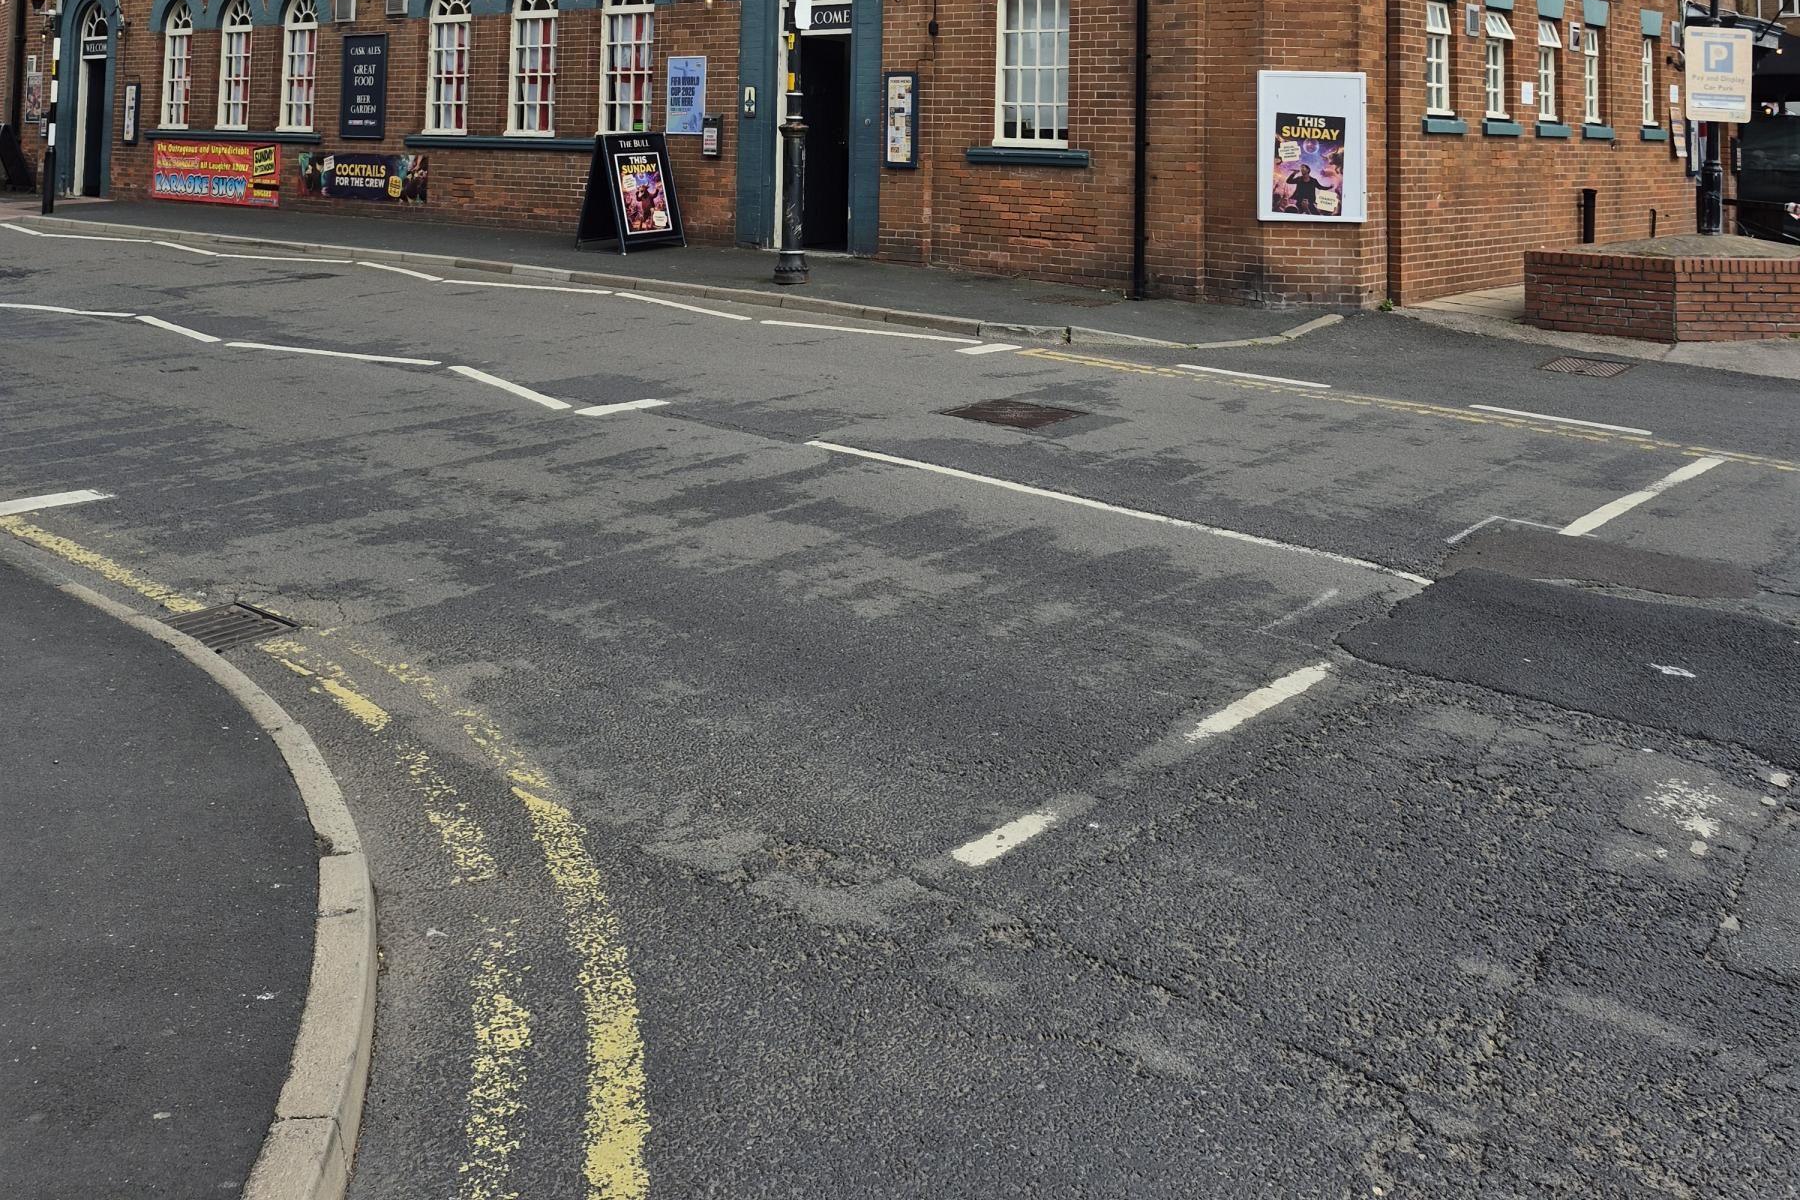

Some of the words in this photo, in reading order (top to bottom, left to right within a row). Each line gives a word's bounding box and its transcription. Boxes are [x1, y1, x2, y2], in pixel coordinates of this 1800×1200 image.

[350, 47, 365, 55] CASK
[368, 46, 381, 54] ALES
[353, 64, 376, 75] GREAT
[354, 76, 374, 86] FOOD
[670, 76, 681, 86] FIFA
[681, 76, 699, 86] WORLD
[1720, 75, 1744, 84] Display
[670, 86, 681, 96] CUP
[681, 86, 695, 96] 2026
[356, 95, 371, 104] BEER
[670, 97, 681, 106] LIVE
[681, 97, 693, 106] HERE
[350, 105, 376, 114] GARDEN
[1297, 116, 1326, 128] THIS
[1282, 126, 1340, 140] SUNDAY
[619, 140, 632, 148] THE
[633, 139, 650, 147] BULL
[157, 143, 166, 152] The
[167, 144, 198, 156] Outrageous
[199, 145, 209, 153] and
[211, 145, 249, 156] Unpredictable
[254, 149, 274, 164] SUNDAY
[629, 156, 647, 164] THIS
[208, 162, 231, 172] Laughter
[335, 163, 386, 178] COCKTAILS
[621, 163, 657, 174] SUNDAY
[155, 171, 210, 197] KARAOKE
[211, 175, 248, 200] SHOW
[335, 177, 349, 186] FOR
[350, 177, 363, 187] THE
[364, 178, 385, 188] CREW
